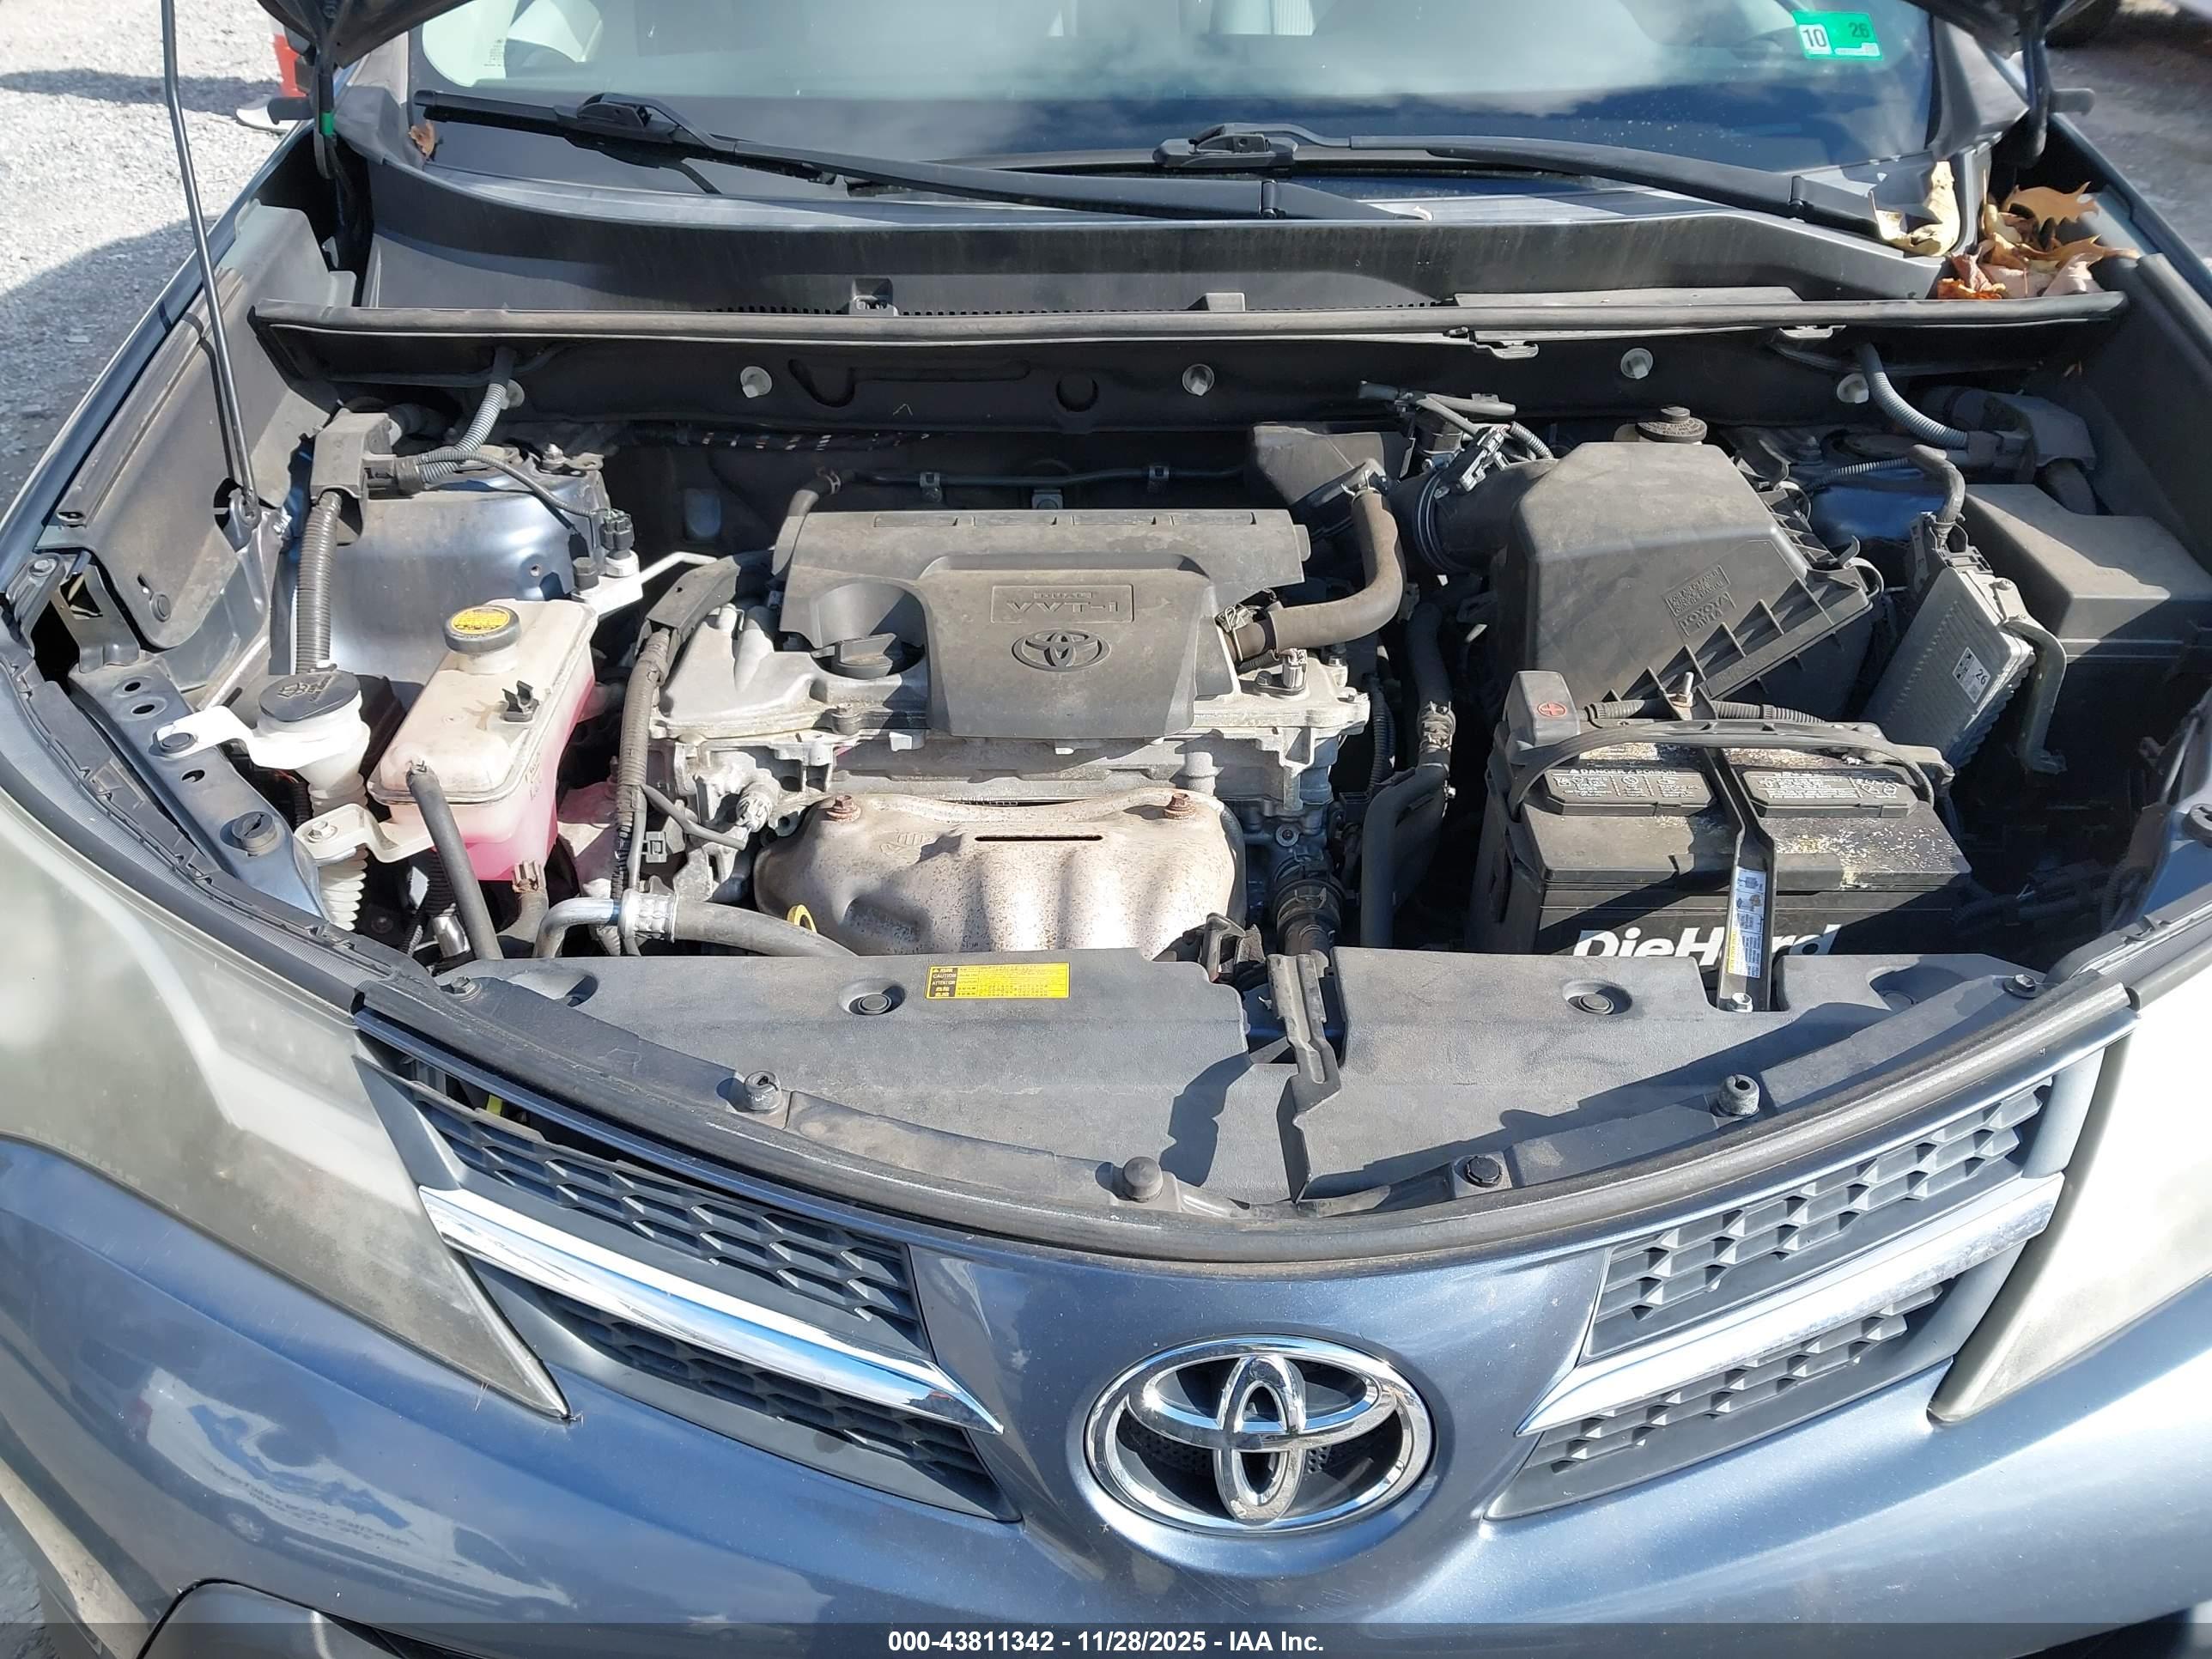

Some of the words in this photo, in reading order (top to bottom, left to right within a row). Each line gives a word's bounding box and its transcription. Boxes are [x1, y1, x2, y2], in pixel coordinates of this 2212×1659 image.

[1803, 28, 1827, 48] 10
[1848, 22, 1870, 39] 26
[1976, 668, 1988, 685] 26
[1573, 924, 1841, 966] DieHrd
